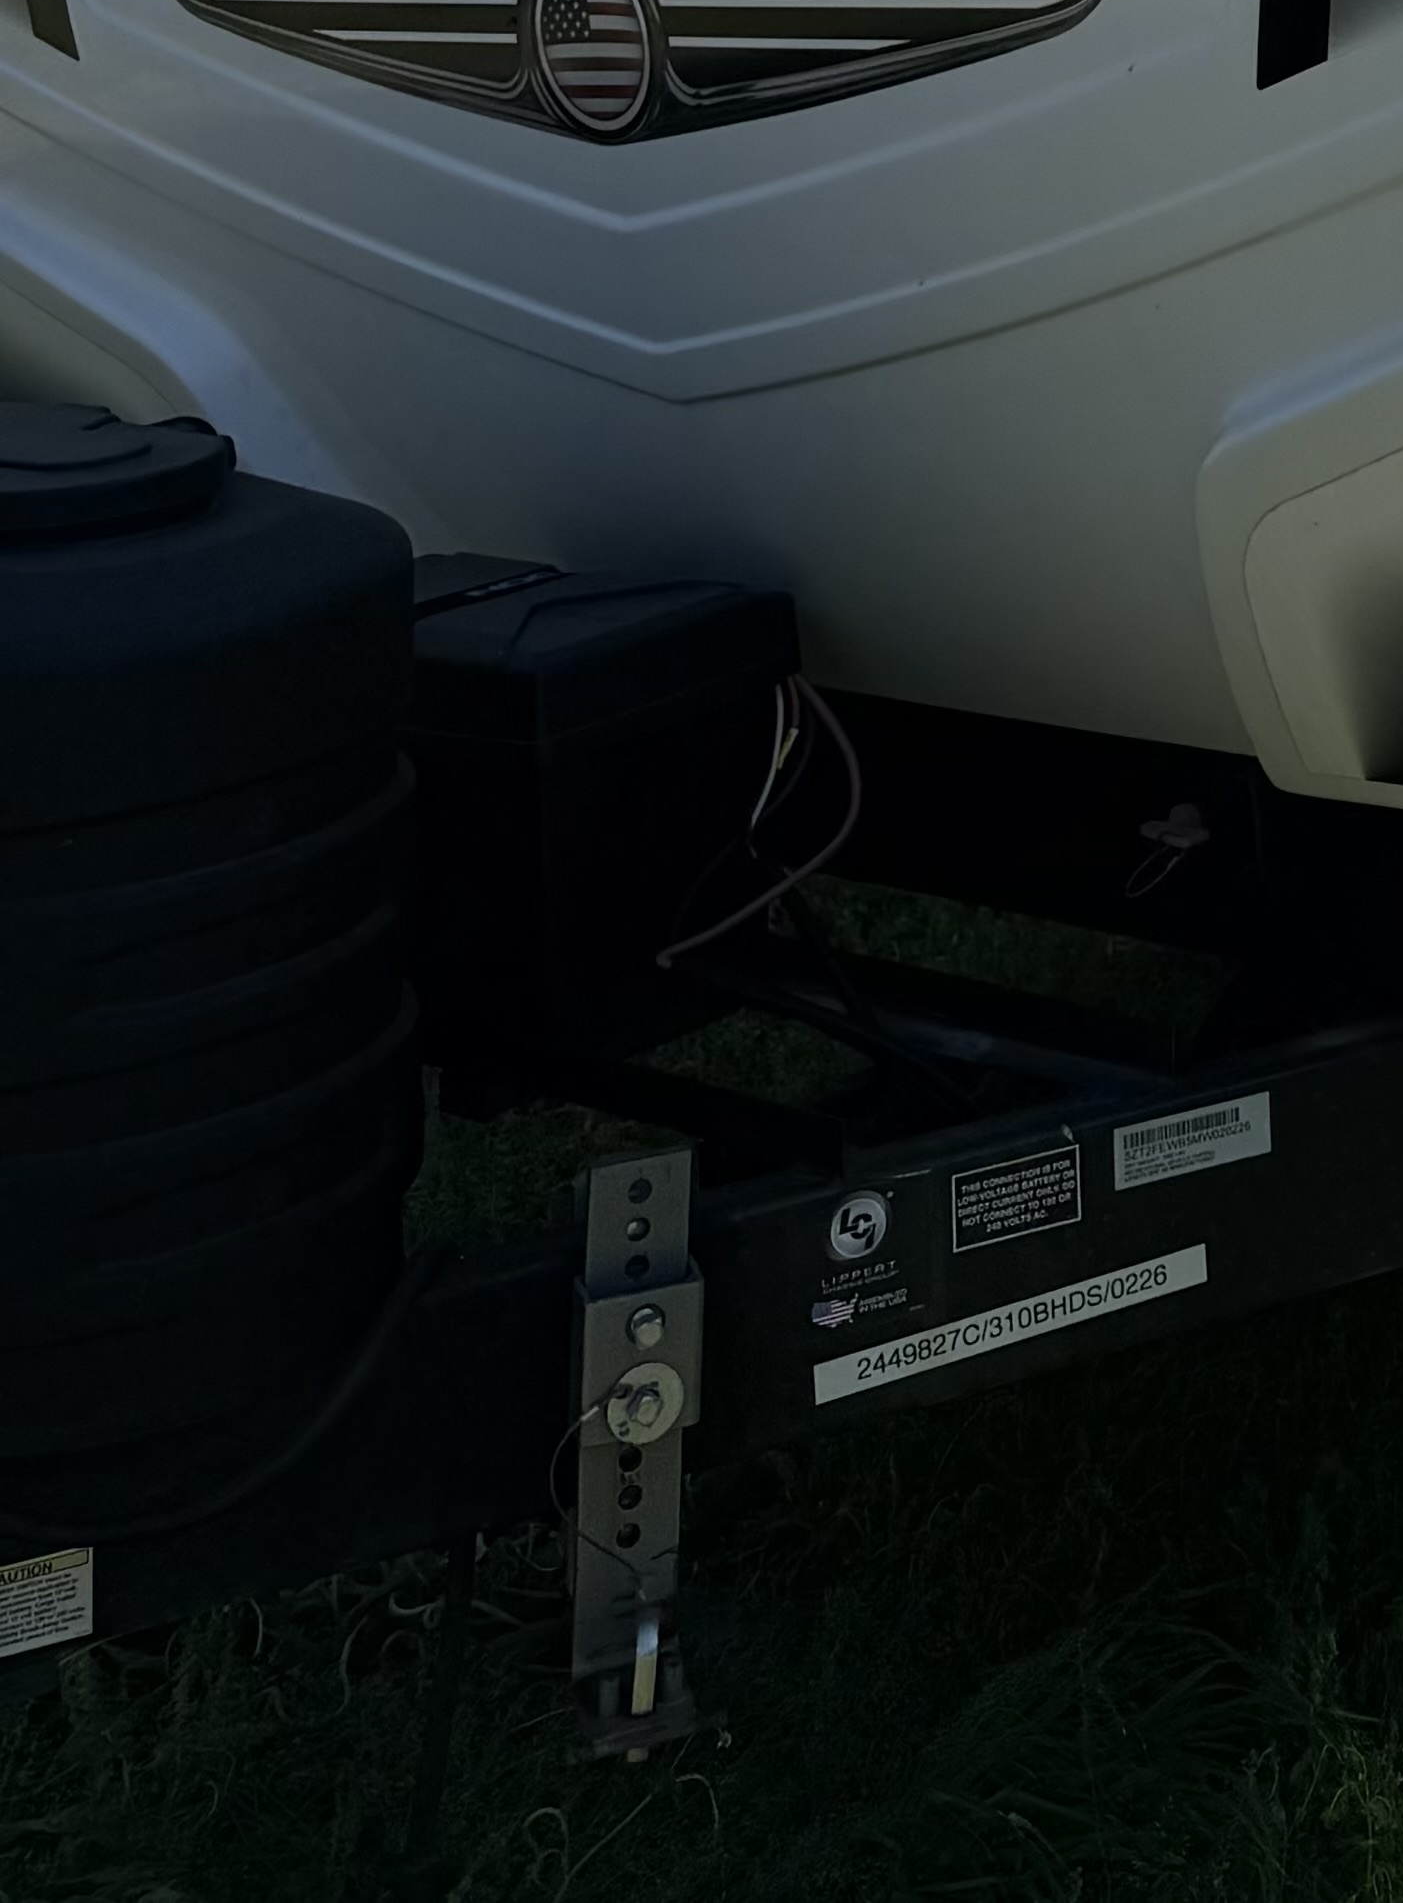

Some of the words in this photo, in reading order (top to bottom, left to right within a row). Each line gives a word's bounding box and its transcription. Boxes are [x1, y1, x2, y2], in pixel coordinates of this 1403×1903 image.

[821, 1259, 897, 1288] LIPPERT
[857, 1263, 1168, 1381] 2449827C/310BHDS/0226
[0, 1560, 53, 1585] AUTION
